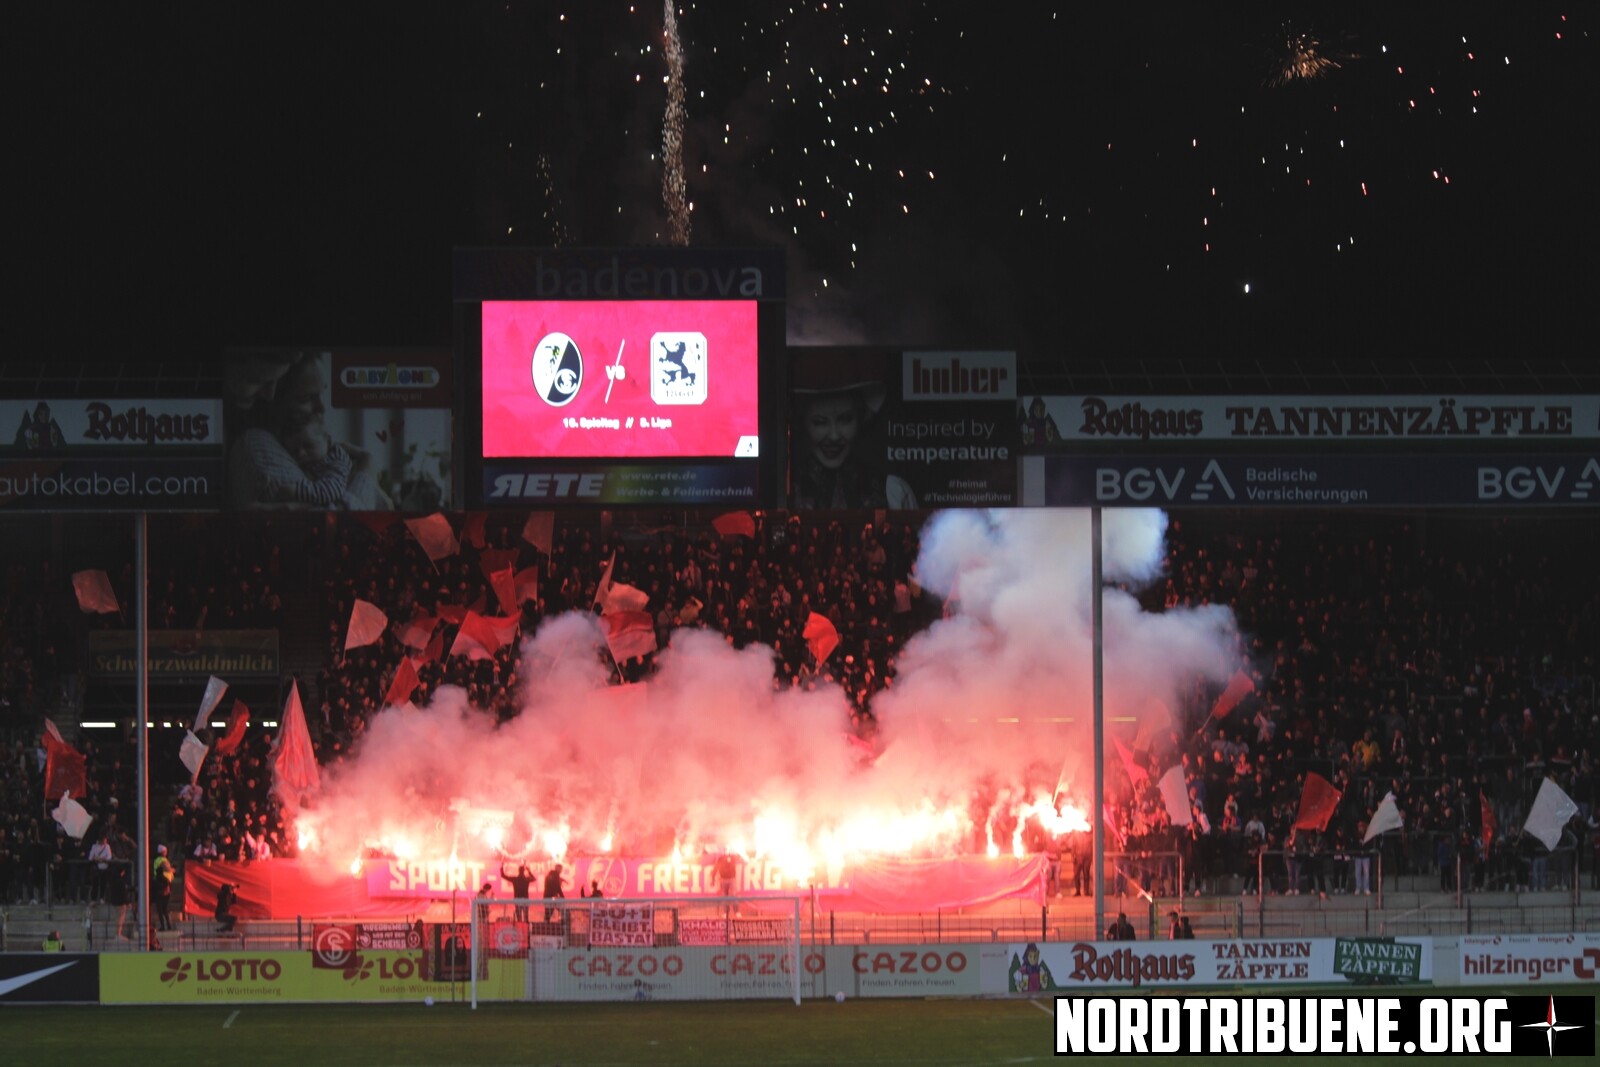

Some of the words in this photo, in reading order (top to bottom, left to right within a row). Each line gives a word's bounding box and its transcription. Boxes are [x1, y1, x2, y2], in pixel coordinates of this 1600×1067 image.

[535, 255, 763, 297] badenova
[912, 358, 1008, 394] huber
[83, 402, 210, 445] Rothaus
[1079, 397, 1205, 441] Rothaus
[1225, 398, 1573, 437] TANNENZÄPFLE
[887, 420, 966, 442] Inspired
[971, 419, 995, 440] by
[887, 445, 1009, 465] temperature
[0, 472, 208, 496] autokabel.com
[620, 470, 697, 480] www.rete.de
[1096, 467, 1185, 501] BGV
[1246, 468, 1318, 482] Badische
[1478, 467, 1566, 499] BGV
[661, 487, 670, 496] &
[673, 486, 754, 497] Folientechnik
[1246, 486, 1369, 503] Versicherungen
[1213, 943, 1311, 958] TANNEN
[1339, 944, 1417, 960] TANNEN
[198, 959, 281, 981] LOTTO
[379, 958, 424, 979] LOT
[568, 955, 683, 977] CAZOO
[852, 952, 967, 974] CAZOO
[1069, 943, 1195, 986] Rothaus
[1217, 963, 1309, 980] ZÄPFLE
[1340, 958, 1414, 976] ZÄPFLE
[1464, 954, 1570, 980] hilzinger
[197, 986, 282, 996] Baden-Württemberg
[862, 979, 893, 987] Finden.
[894, 979, 923, 988] Fahren.
[926, 979, 956, 987] Freuen.
